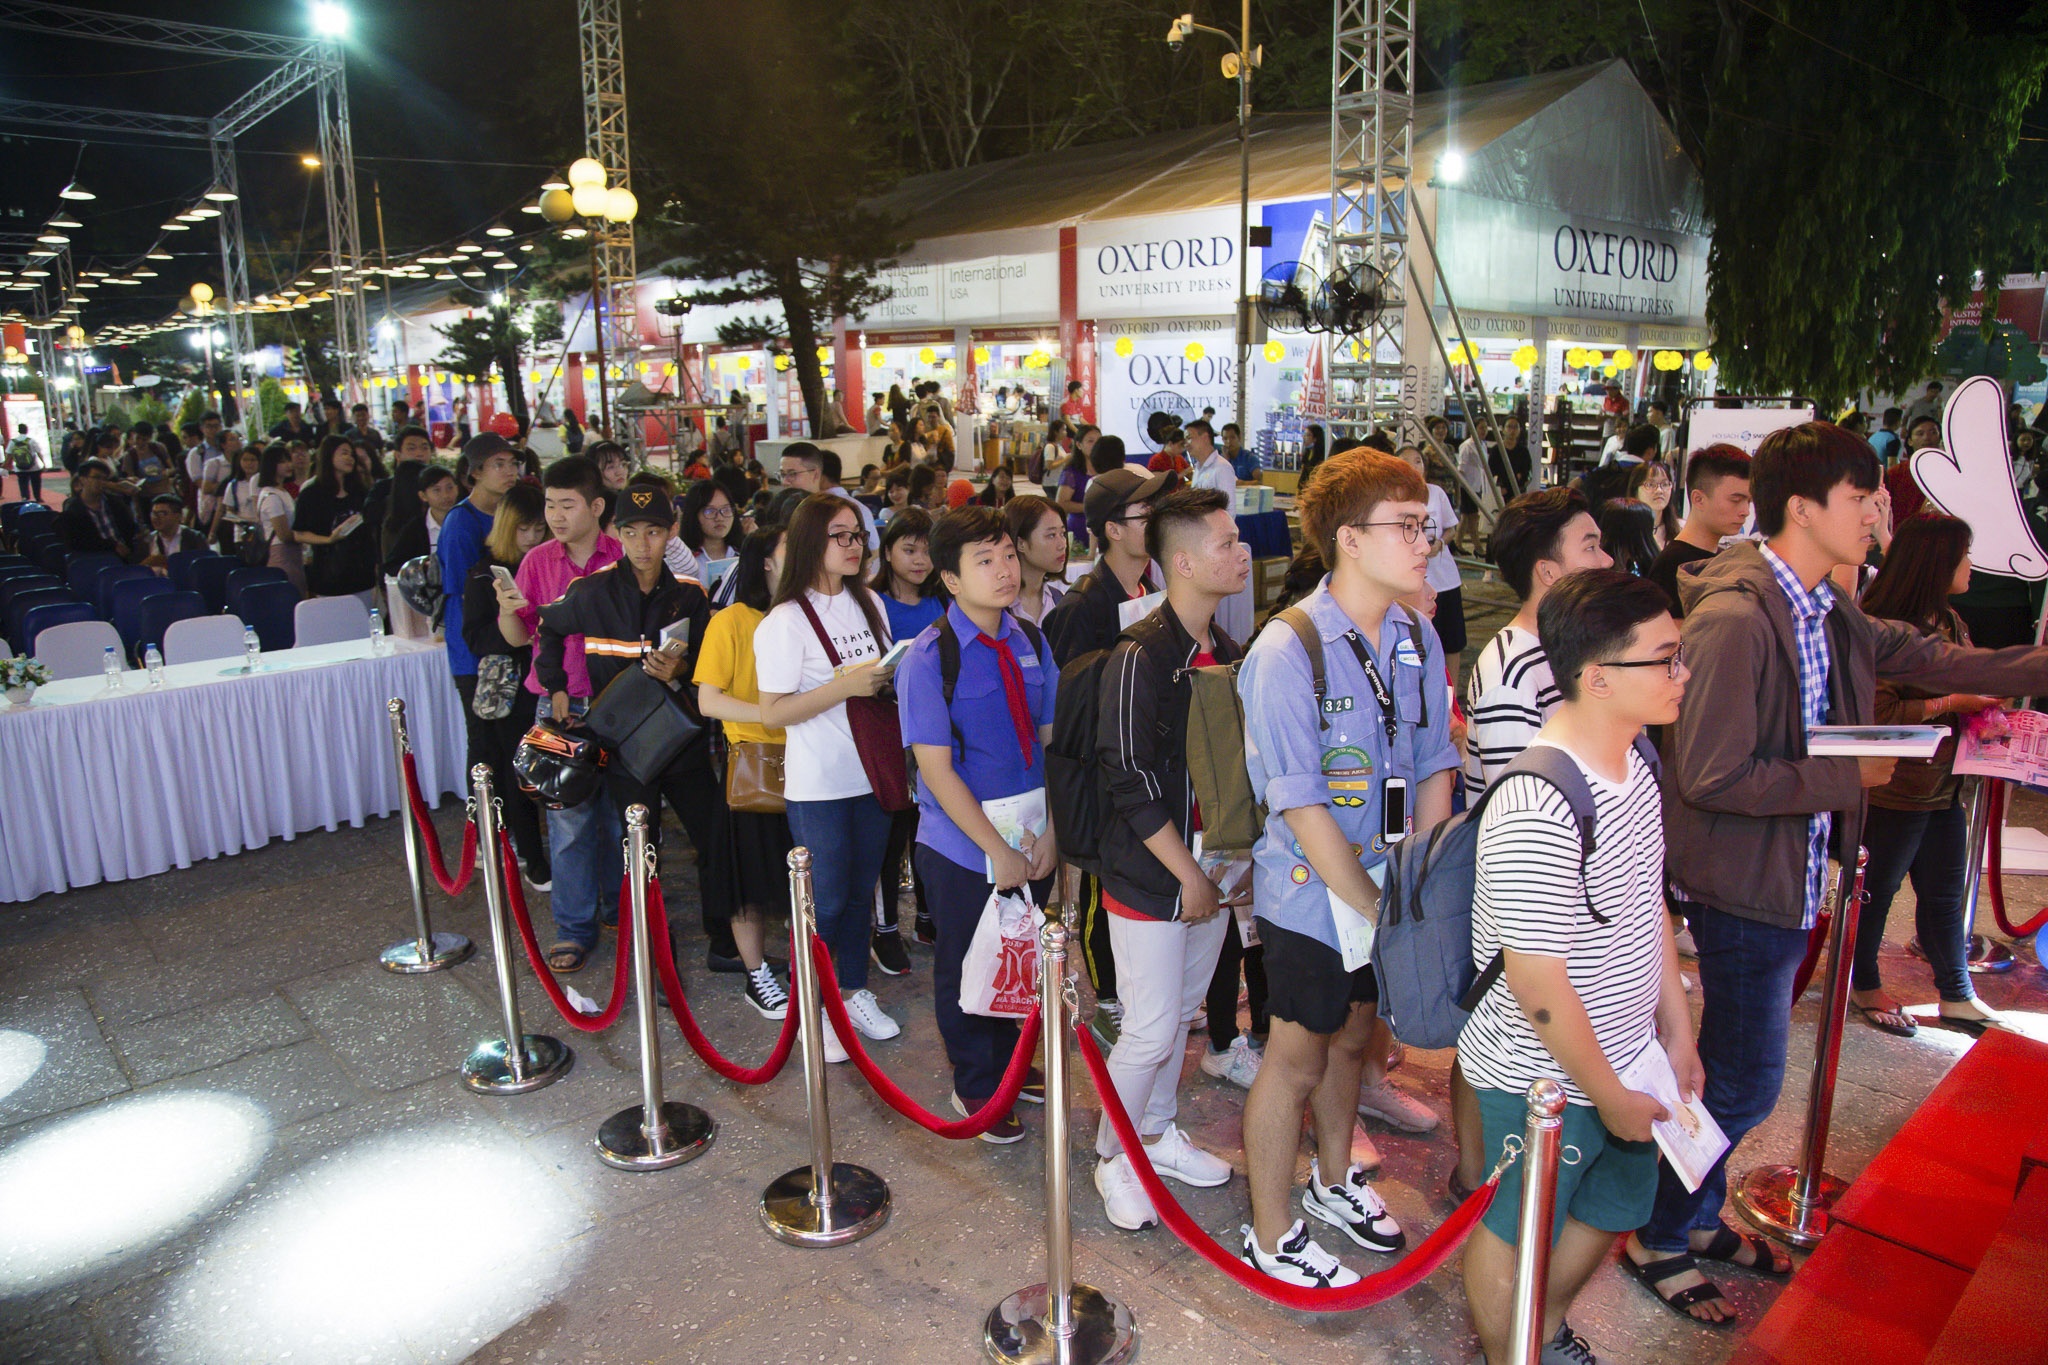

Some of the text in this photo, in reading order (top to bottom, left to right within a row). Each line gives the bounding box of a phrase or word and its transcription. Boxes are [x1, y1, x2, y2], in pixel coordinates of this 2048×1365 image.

[1098, 236, 1233, 275] OXFORD
[1554, 225, 1678, 283] OXFORD
[950, 261, 1026, 283] International
[950, 288, 969, 300] USA
[1099, 278, 1232, 298] UNIVERSITY PRESS
[880, 302, 918, 316] House
[1554, 288, 1674, 316] UNIVERSITY PRESS
[1109, 320, 1222, 335] OXFORD OXFORD
[1486, 318, 1526, 332] OXFORD
[1547, 322, 1618, 338] OXFORD OXFORD
[1640, 328, 1700, 343] OXFORD OXFORD
[1292, 346, 1304, 357] We
[1129, 354, 1256, 386] OXFOR
[1130, 396, 1214, 410] UNIVERSITY
[840, 644, 875, 660] LOOK
